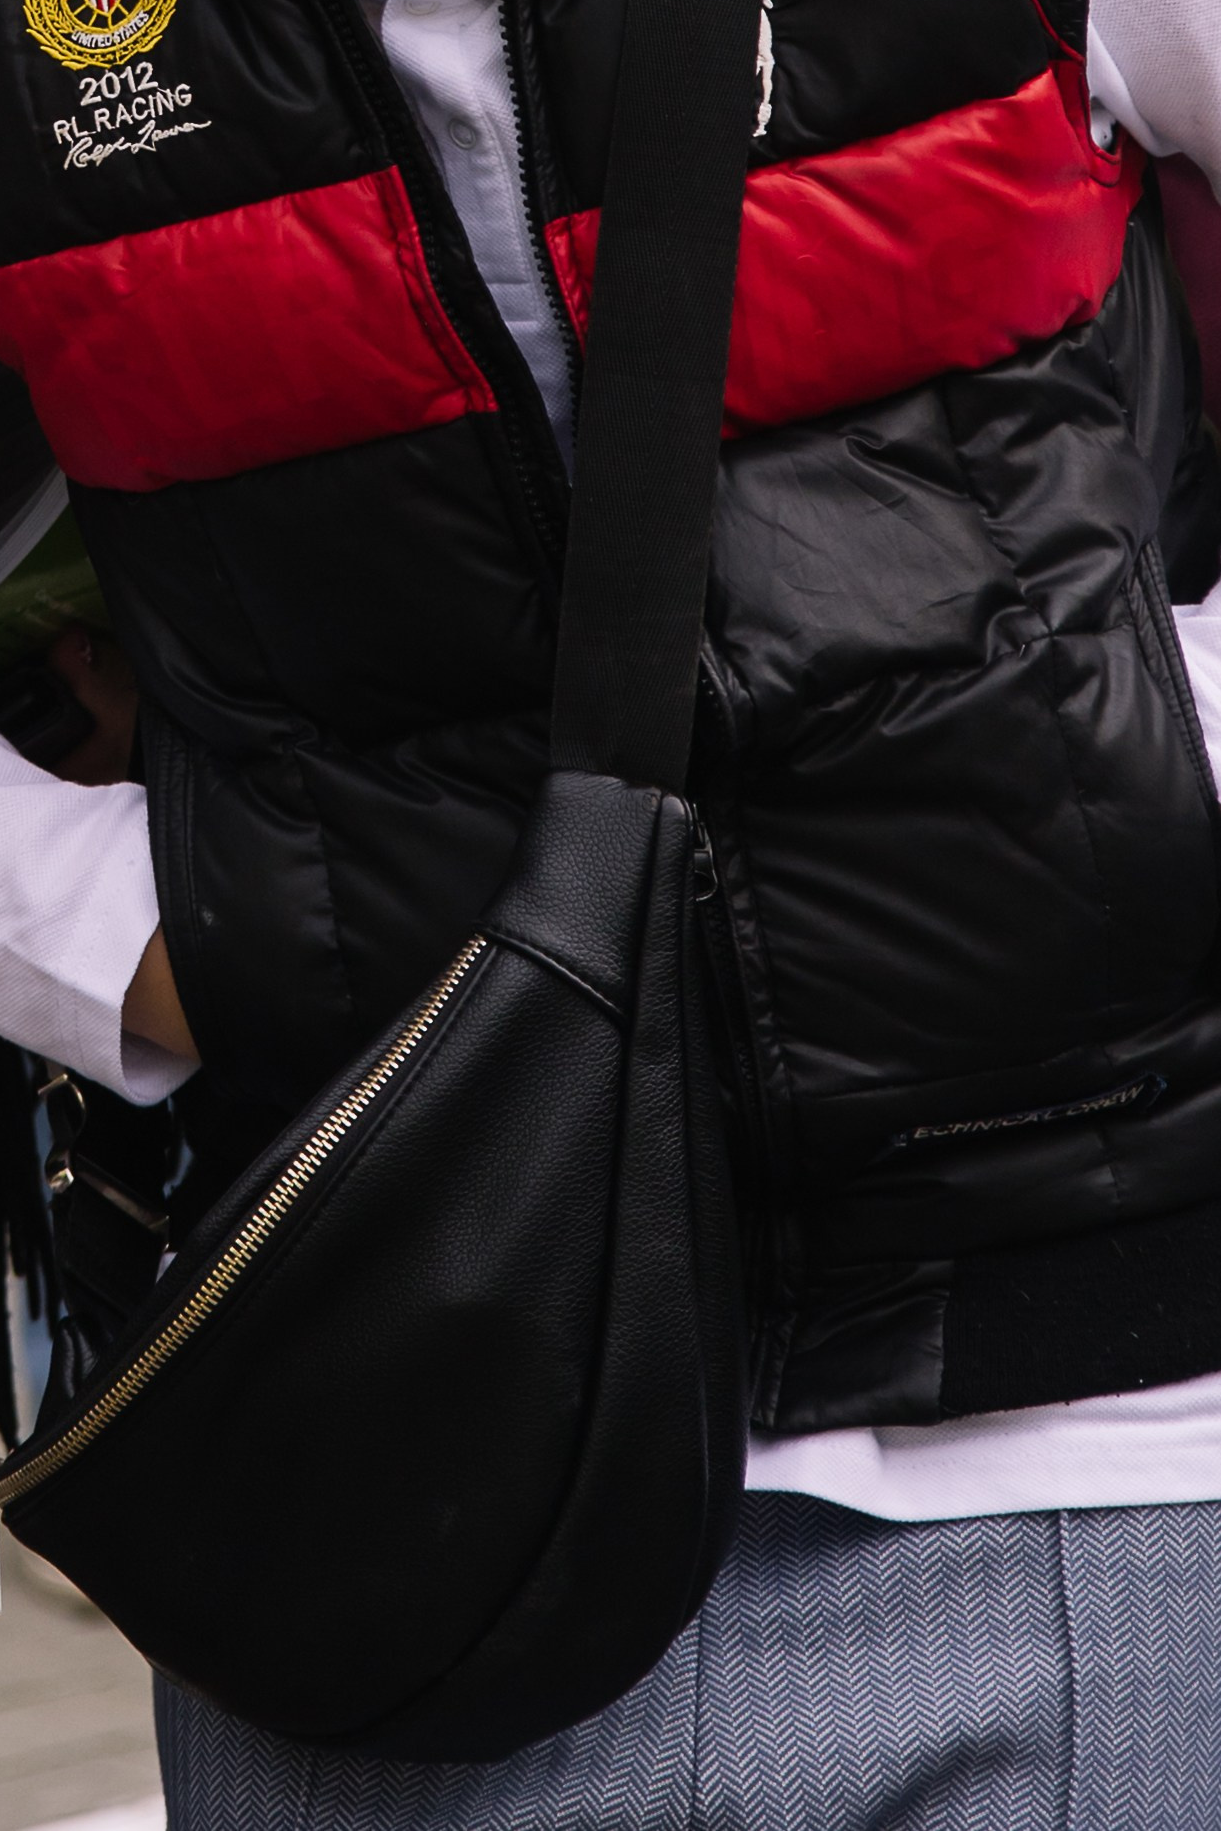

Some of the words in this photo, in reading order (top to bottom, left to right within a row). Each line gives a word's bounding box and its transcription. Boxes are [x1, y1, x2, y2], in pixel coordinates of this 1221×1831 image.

[71, 28, 113, 48] UNITED
[113, 11, 150, 45] STATES
[79, 61, 159, 107] 2012
[94, 83, 193, 133] RACING
